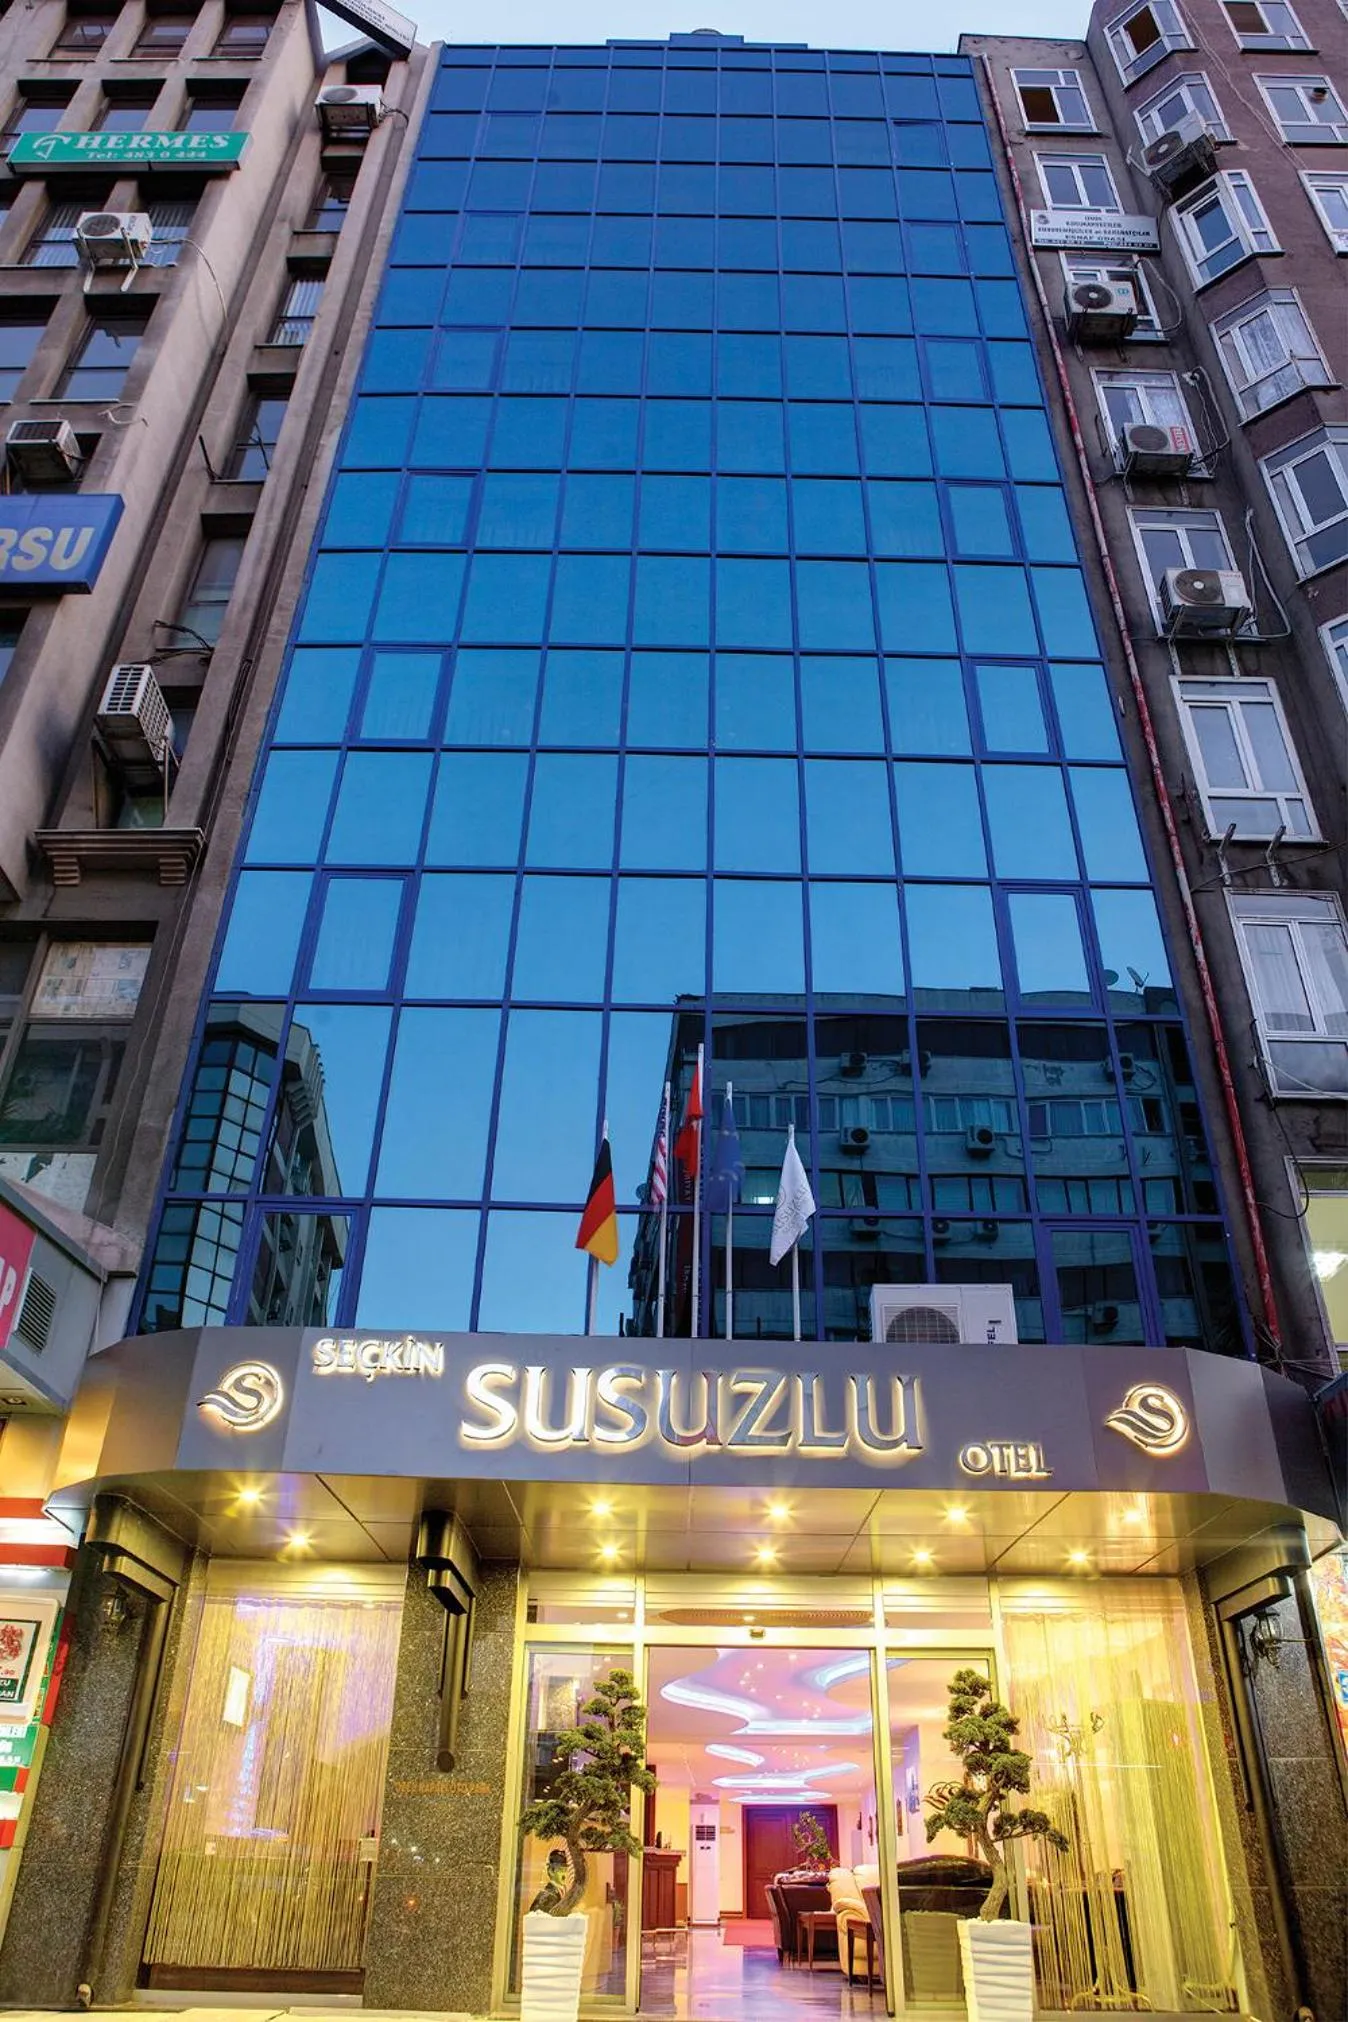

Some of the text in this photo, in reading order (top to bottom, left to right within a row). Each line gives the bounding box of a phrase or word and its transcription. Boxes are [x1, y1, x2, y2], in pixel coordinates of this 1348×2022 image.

[74, 134, 230, 149] HERMES
[313, 1335, 445, 1380] SEÇKİN
[460, 1363, 924, 1451] SUSUZLU
[960, 1443, 1054, 1476] OTEL
